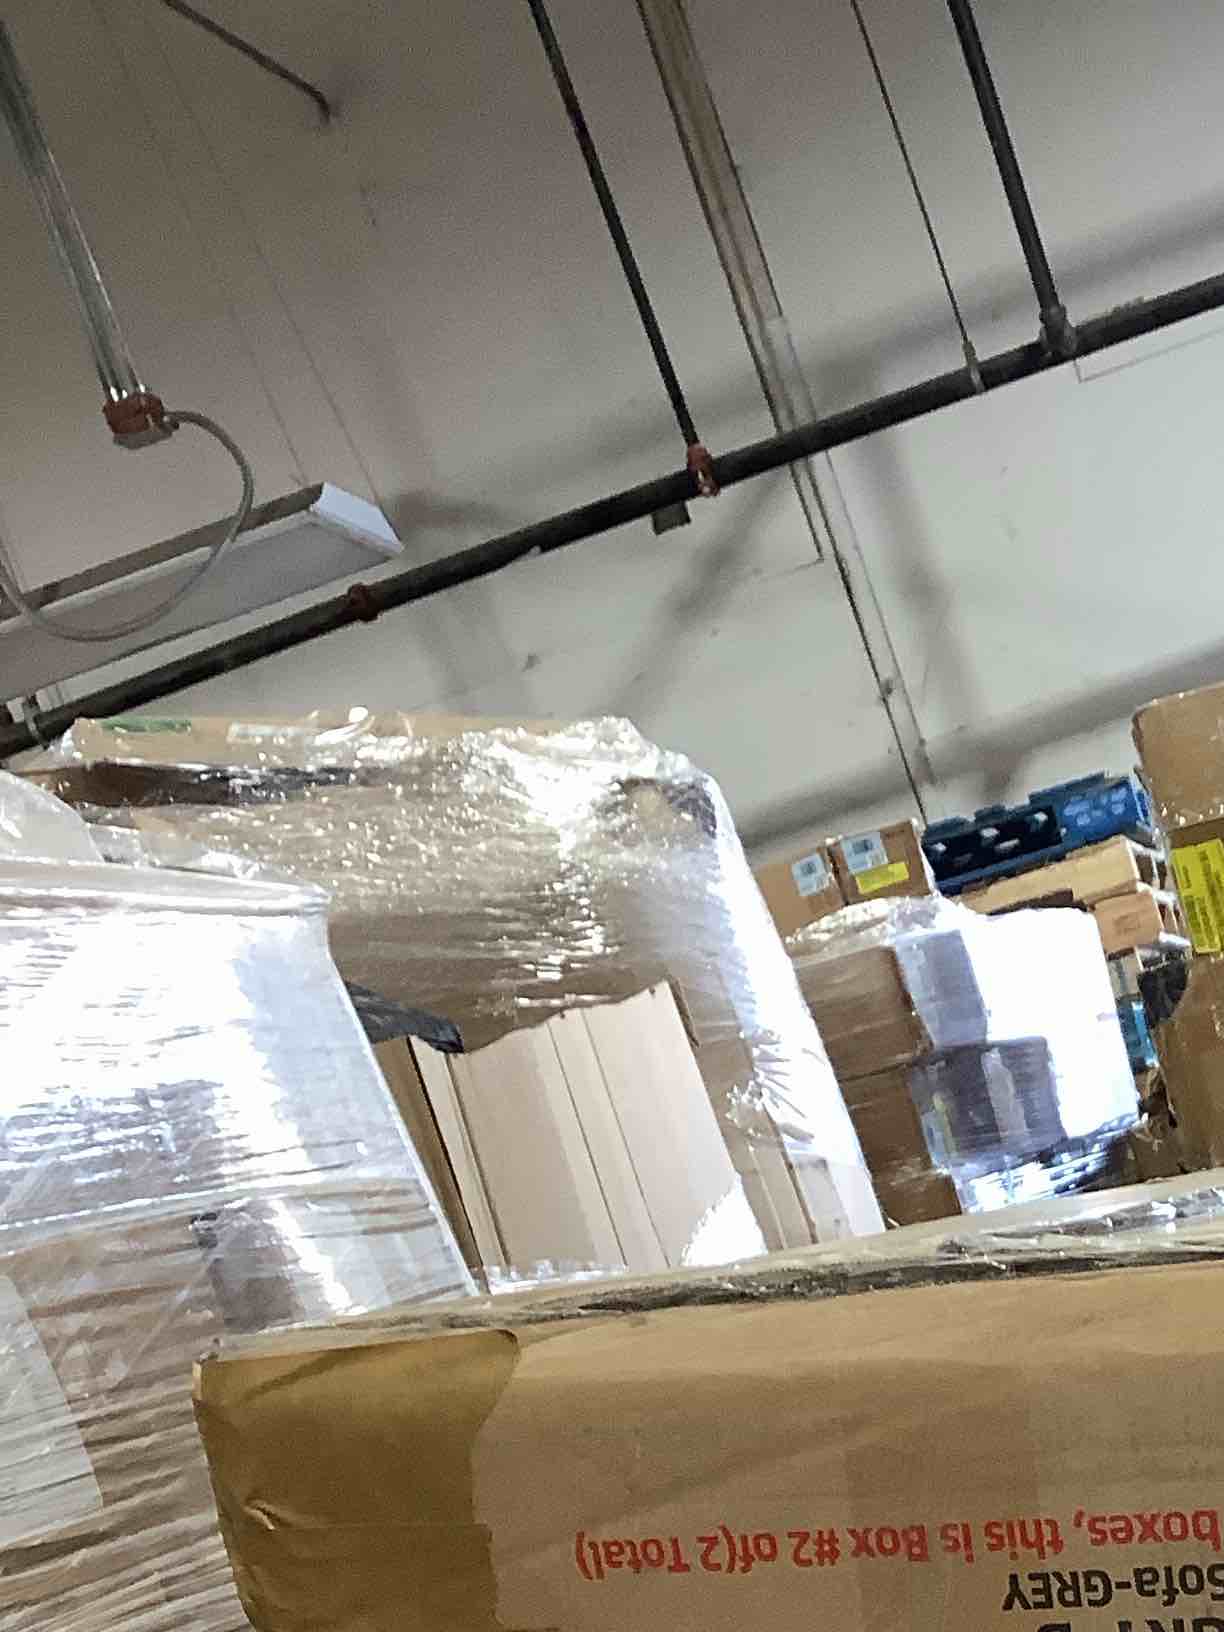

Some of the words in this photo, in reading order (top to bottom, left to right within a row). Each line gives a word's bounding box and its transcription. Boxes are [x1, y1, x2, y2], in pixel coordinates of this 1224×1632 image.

[787, 1527, 841, 1568] #2
[847, 1523, 930, 1563] Box
[938, 1520, 974, 1564] is
[985, 1517, 1064, 1561] this
[1073, 1508, 1222, 1553] boxes,
[574, 1530, 691, 1581] Total)
